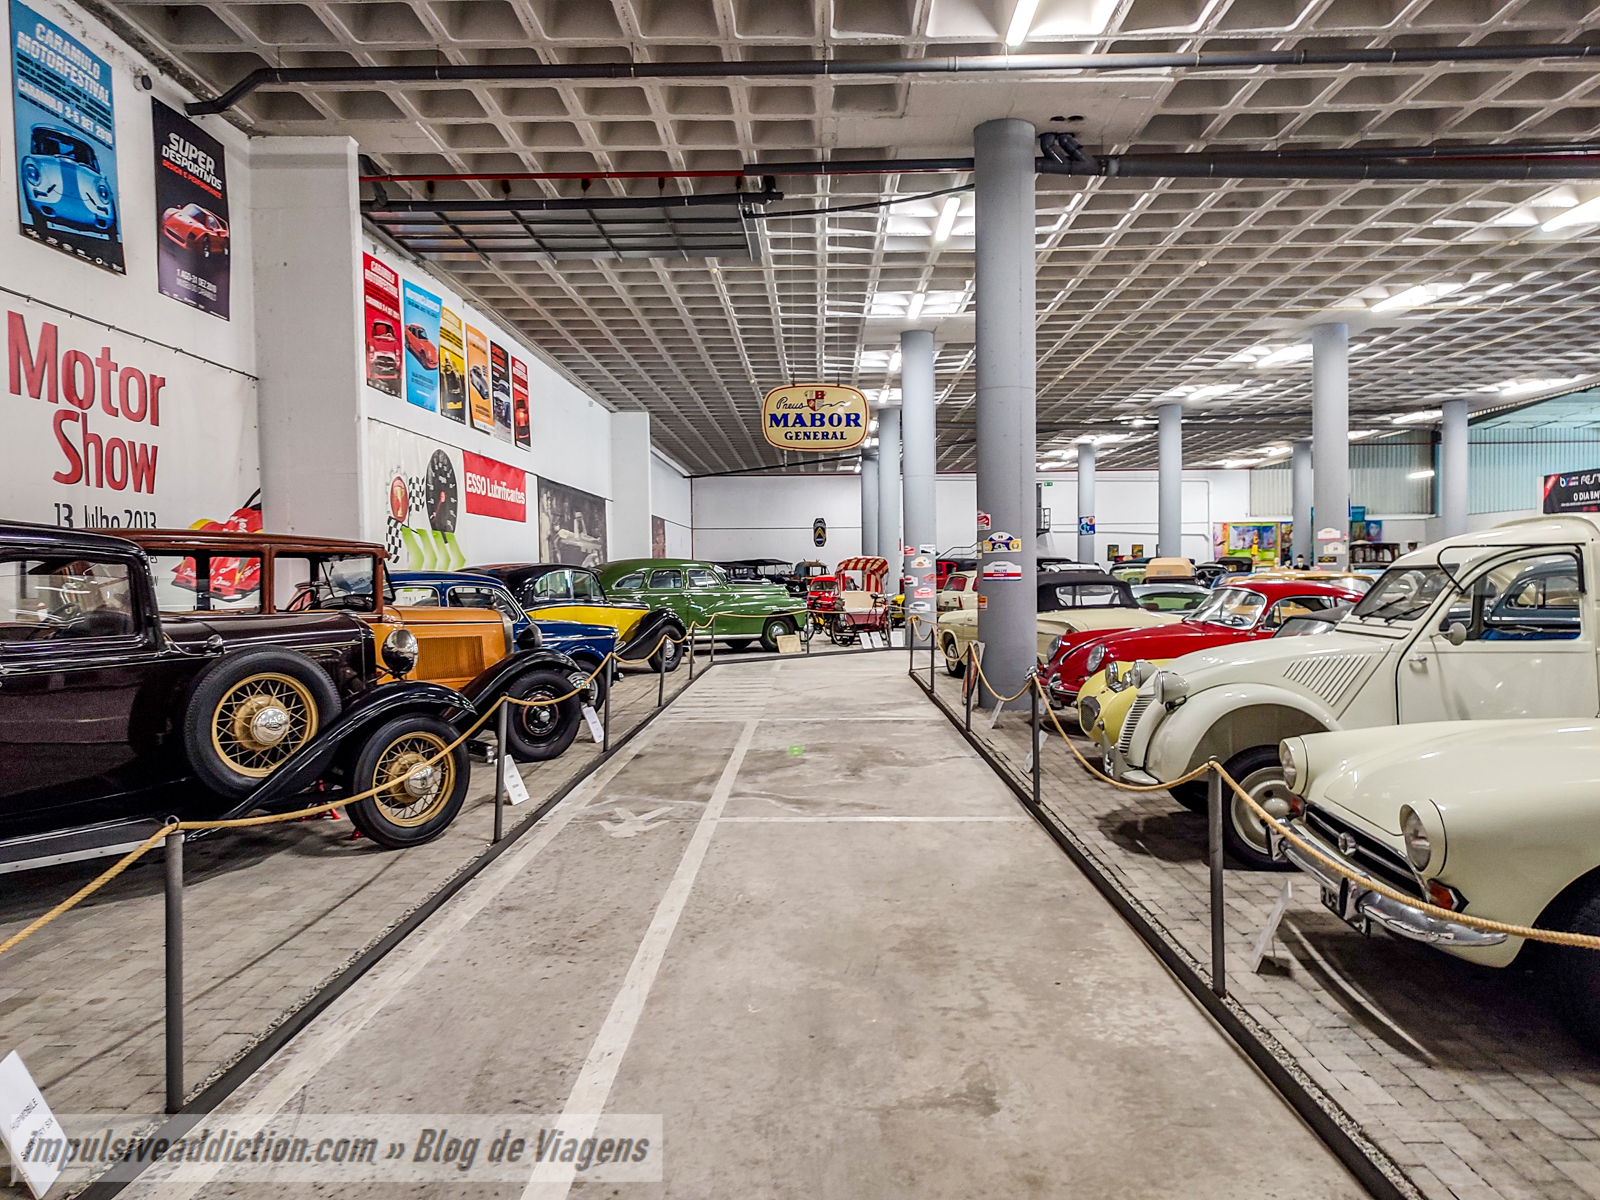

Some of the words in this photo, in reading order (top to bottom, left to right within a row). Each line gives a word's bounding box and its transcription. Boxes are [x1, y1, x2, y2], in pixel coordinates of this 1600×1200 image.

[17, 31, 111, 107] MOTORFESTIVAL
[35, 23, 100, 80] CARAMULO
[162, 145, 222, 190] DESPORTIVOS
[168, 132, 215, 175] SUPER
[8, 310, 165, 427] Motor
[769, 412, 862, 428] MABOR
[776, 396, 804, 410] Pneus
[53, 409, 158, 494] Show
[784, 431, 847, 440] GENERAL
[466, 472, 487, 496] ESSO
[487, 477, 526, 505] Lubrificantes
[54, 503, 73, 529] 13
[123, 509, 156, 529] 2013
